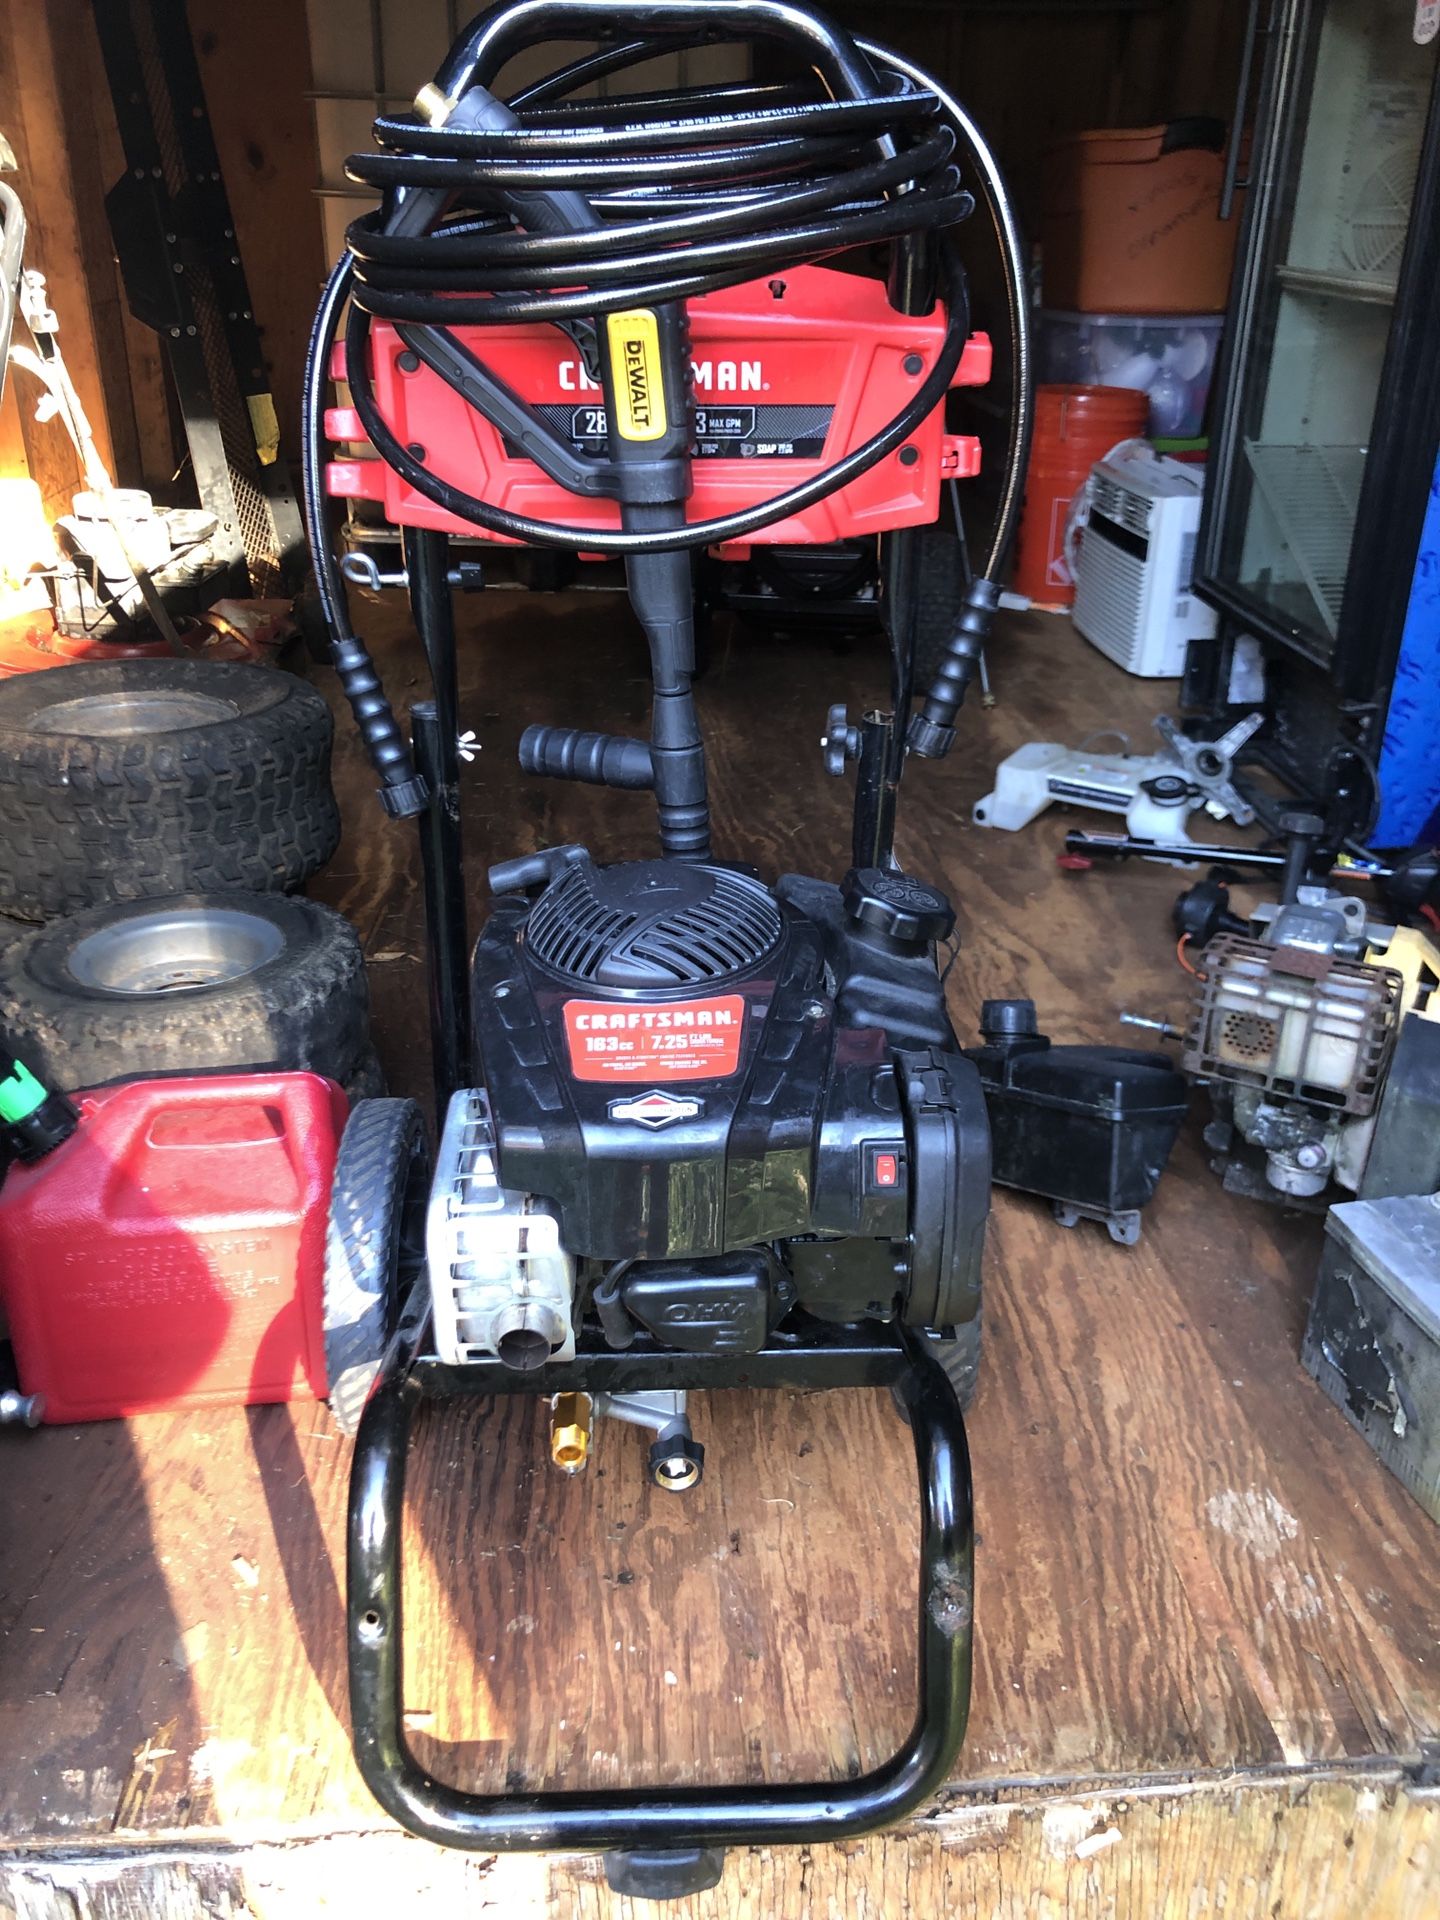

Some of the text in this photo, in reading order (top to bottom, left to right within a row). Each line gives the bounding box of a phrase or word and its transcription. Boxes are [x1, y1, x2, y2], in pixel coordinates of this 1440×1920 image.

[558, 361, 763, 391] CRMAN
[708, 418, 725, 428] MAX
[725, 418, 742, 428] GPM
[575, 1009, 732, 1031] CRAFTSMAN
[651, 1034, 688, 1050] 7.25
